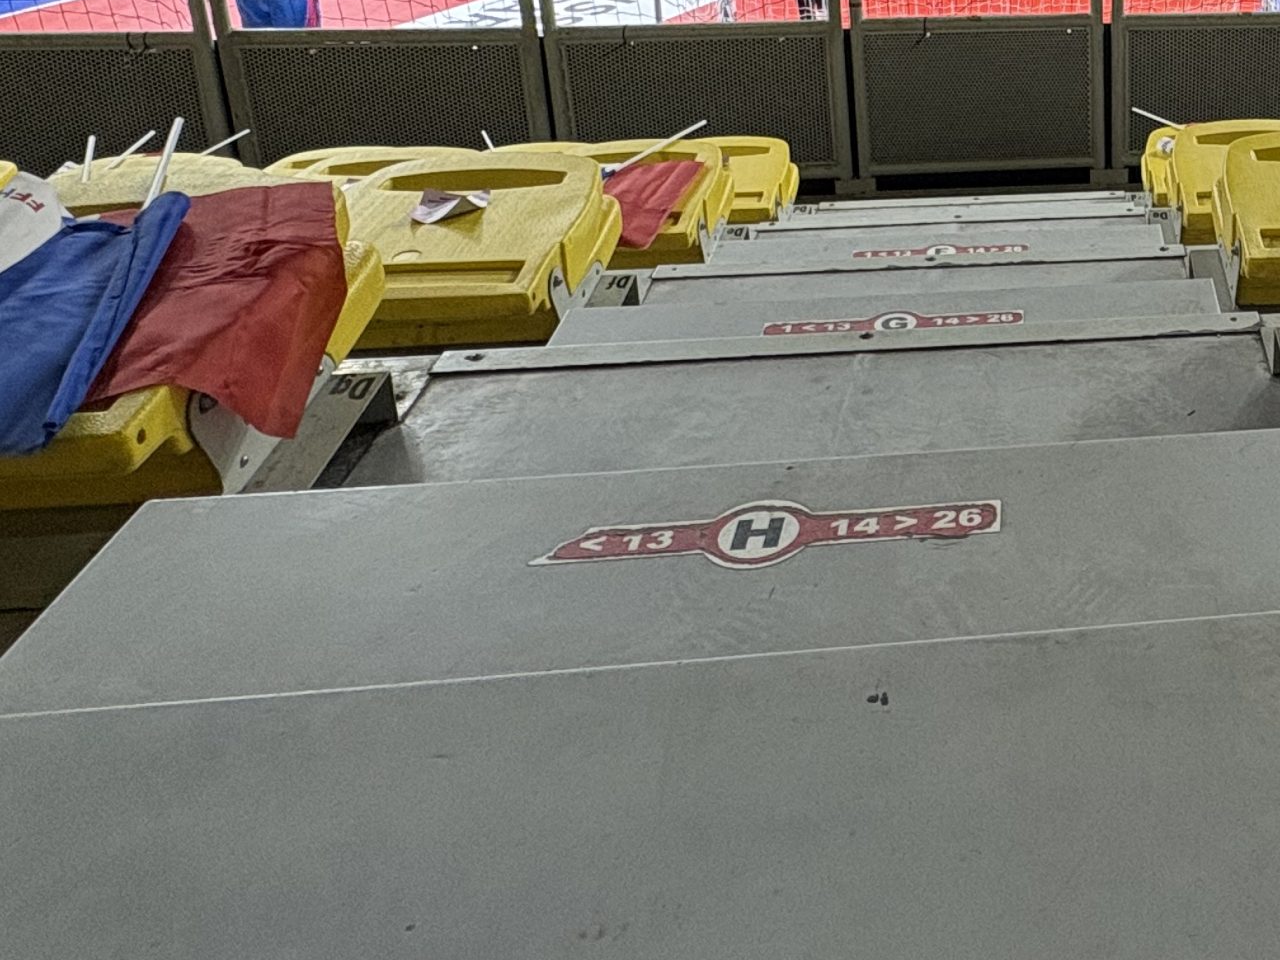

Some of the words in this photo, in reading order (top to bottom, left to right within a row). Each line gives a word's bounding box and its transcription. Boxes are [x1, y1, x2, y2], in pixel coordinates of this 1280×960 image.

[824, 322, 851, 332] 13
[880, 316, 910, 331] G
[932, 316, 960, 327] 14
[622, 530, 674, 551] 13
[730, 516, 787, 551] H
[830, 516, 881, 537] 14
[934, 509, 983, 530] 26
